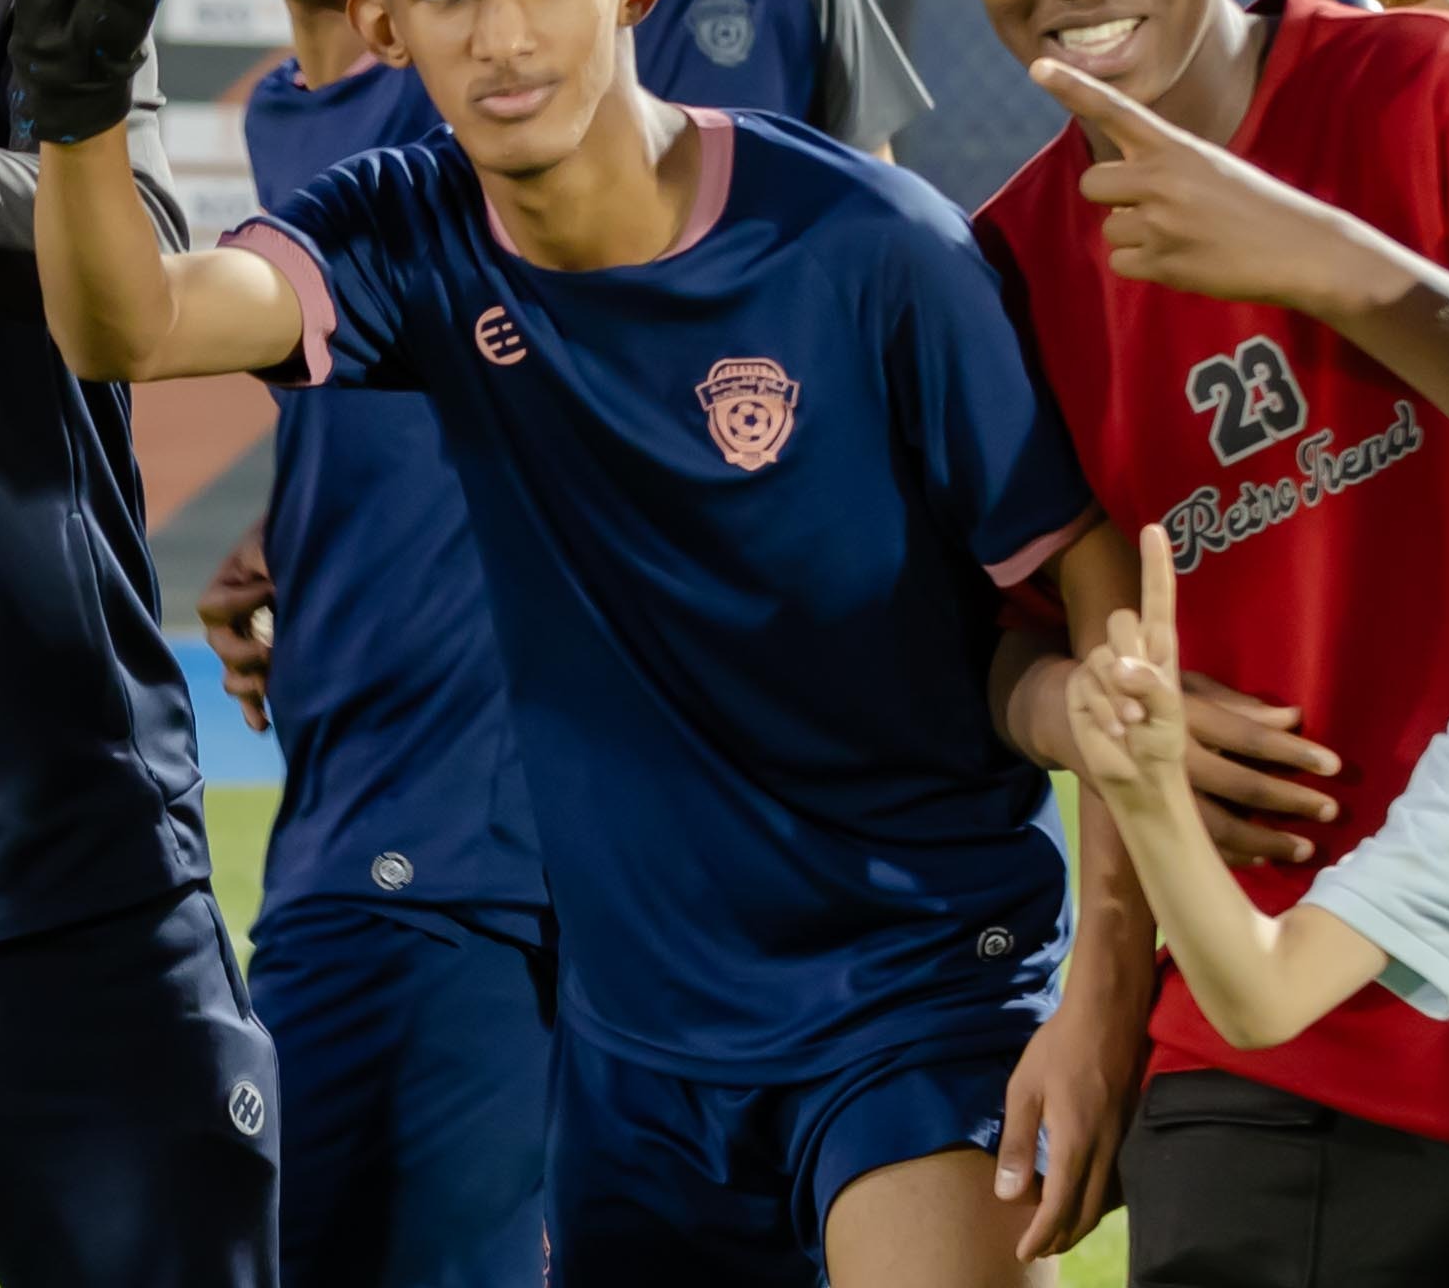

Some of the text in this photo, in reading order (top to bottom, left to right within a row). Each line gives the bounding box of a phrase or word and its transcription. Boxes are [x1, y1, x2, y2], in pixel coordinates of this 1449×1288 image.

[1185, 334, 1309, 467] 23
[1161, 400, 1423, 574] Retro Trend
